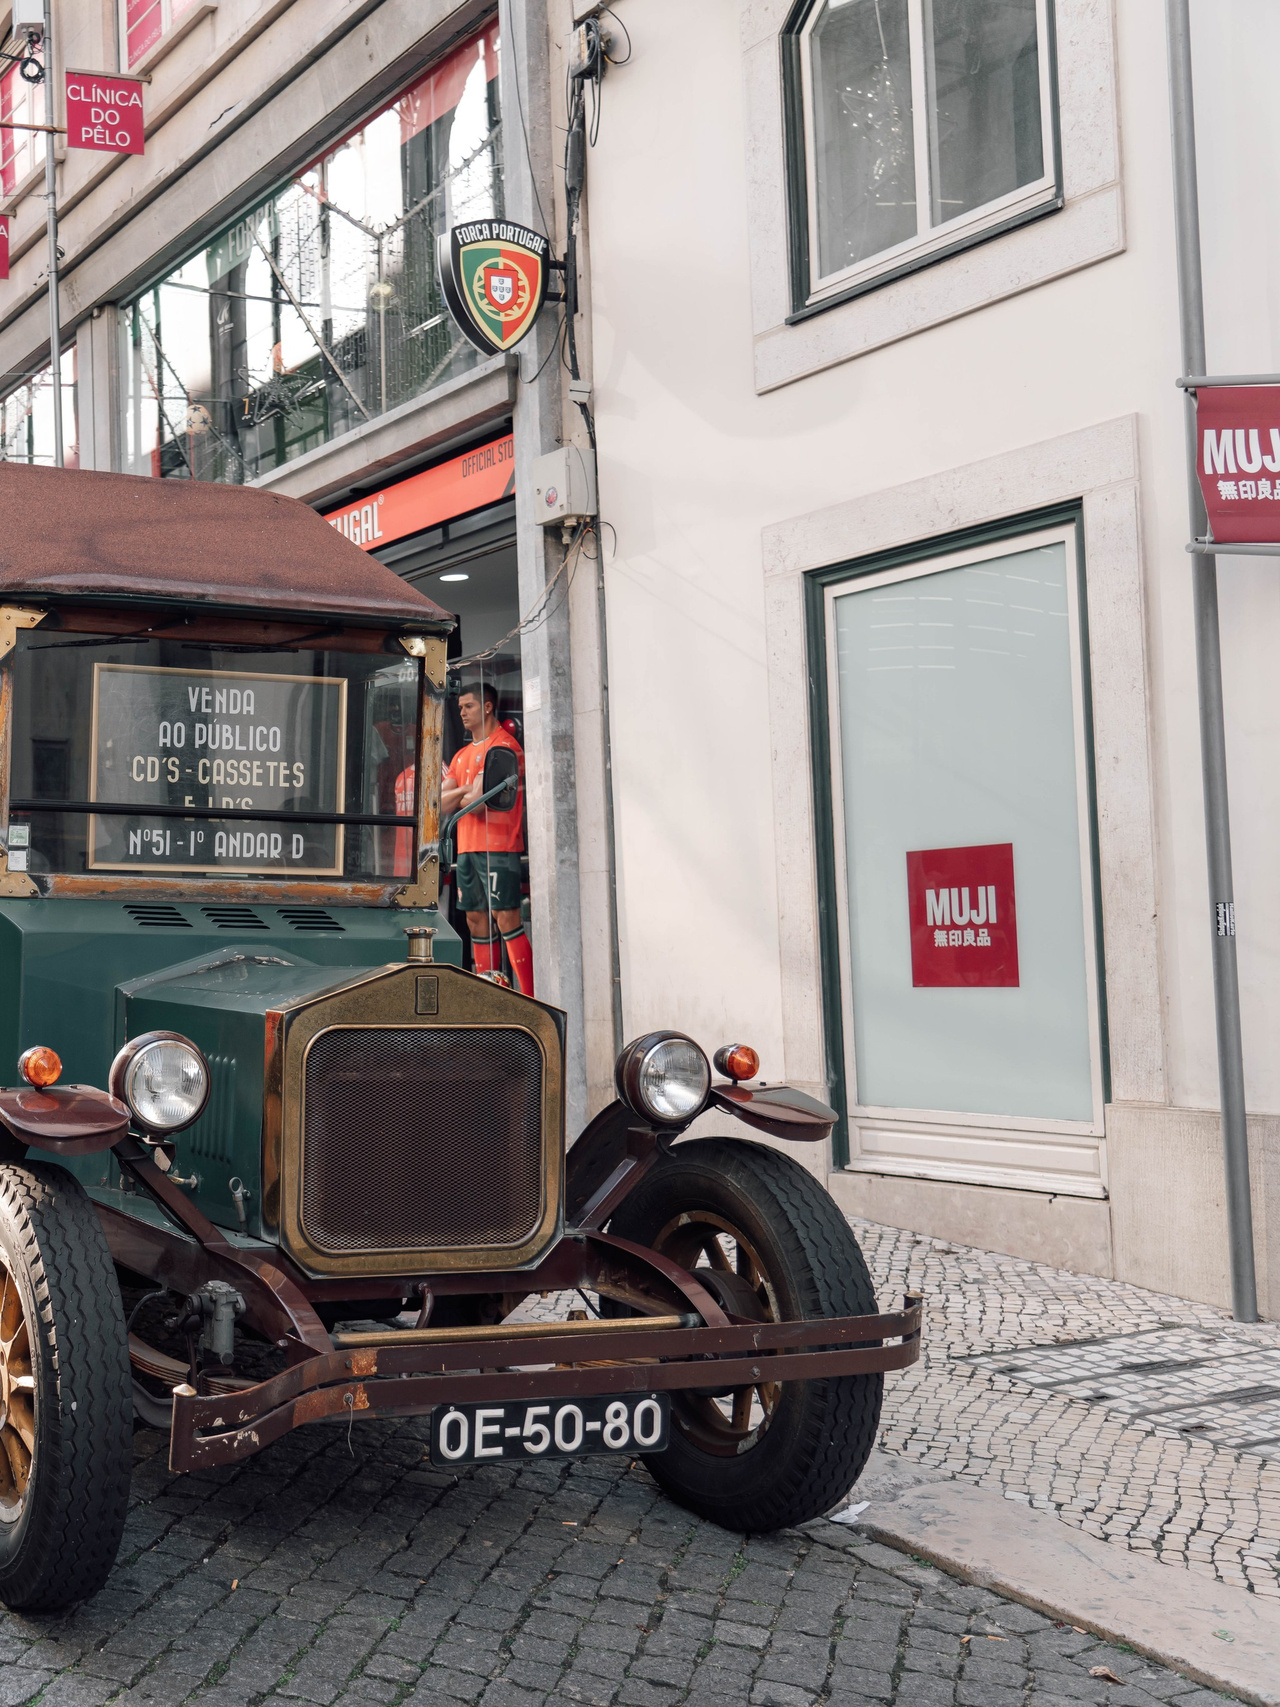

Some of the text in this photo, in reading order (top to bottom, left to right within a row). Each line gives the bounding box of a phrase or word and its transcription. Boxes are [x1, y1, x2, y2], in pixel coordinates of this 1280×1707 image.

[67, 84, 143, 108] CLÍNICA
[91, 108, 120, 125] DO
[81, 126, 130, 147] PÊLO
[455, 223, 491, 245] FORÇA
[462, 439, 514, 478] OFFICIAL STO
[1203, 428, 1280, 475] MUJ
[187, 686, 255, 715] VENDA
[159, 718, 281, 752] AO PÚBLICO
[198, 758, 305, 788] CASSETES
[214, 831, 282, 859] ANDAR
[292, 833, 304, 860] D
[489, 871, 498, 892] 7
[925, 885, 997, 926] MUJI
[933, 928, 991, 947] 無印良品
[439, 1399, 661, 1460] OE-50-80
